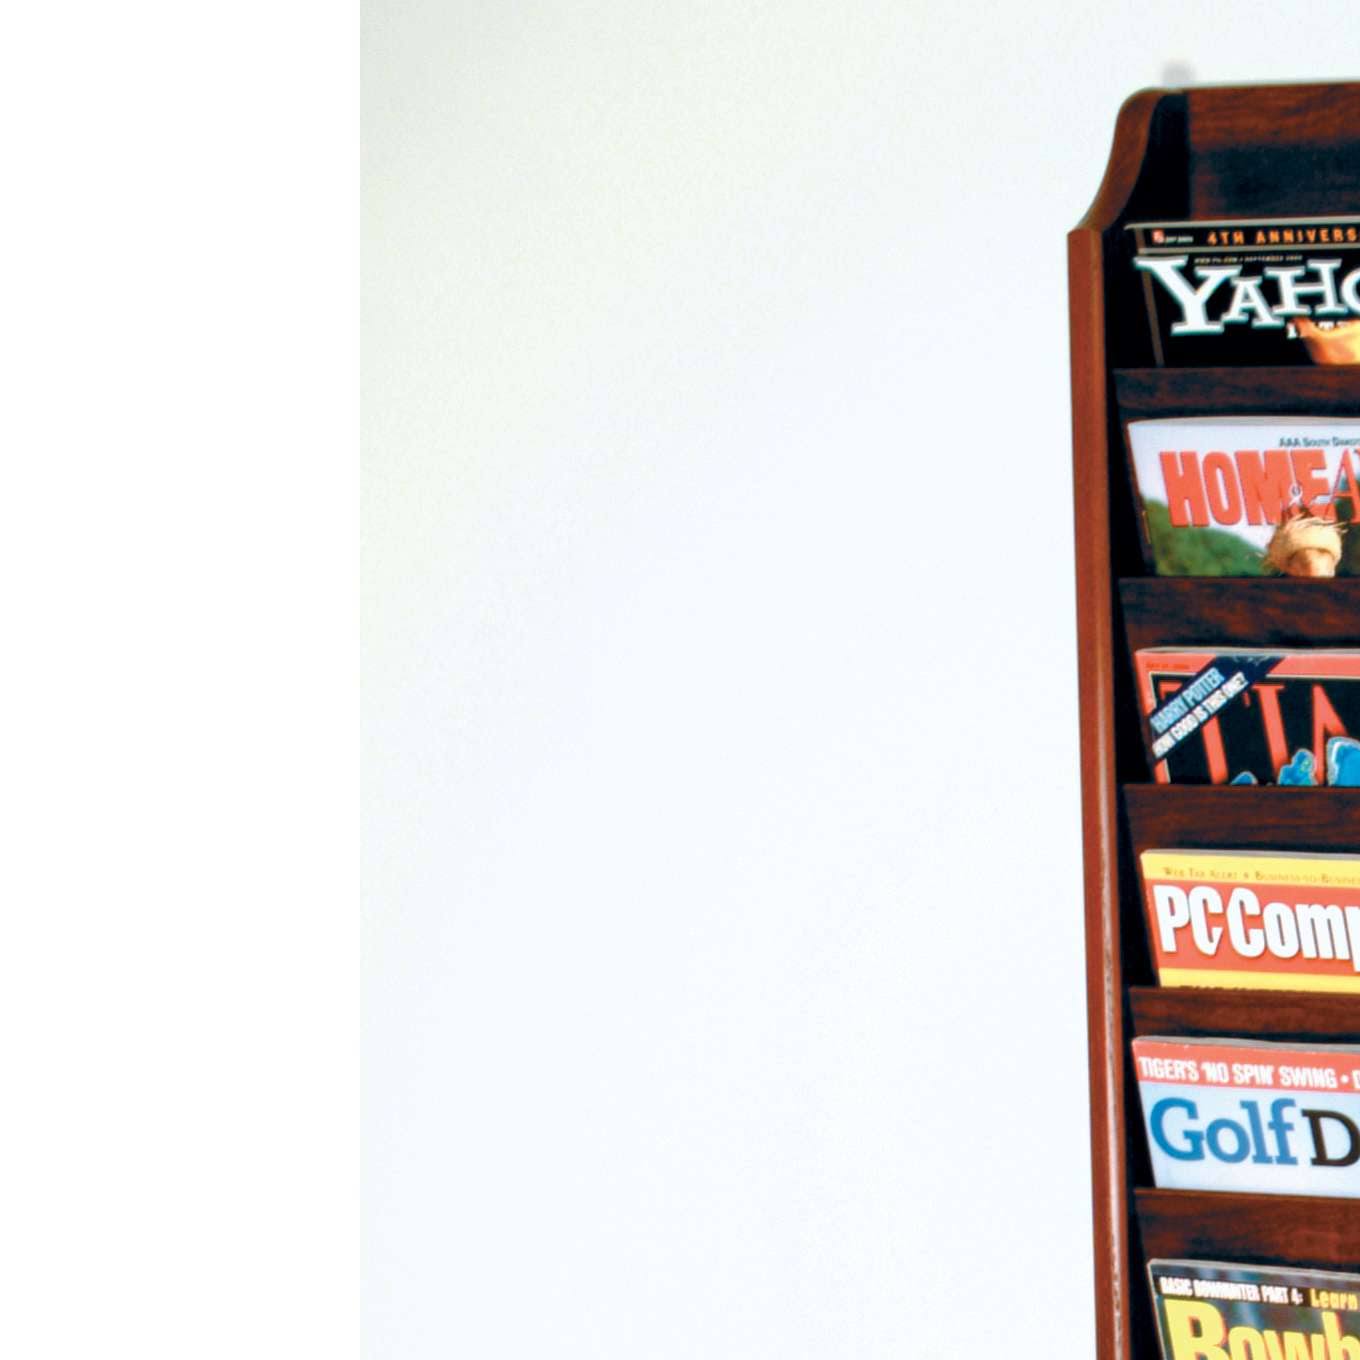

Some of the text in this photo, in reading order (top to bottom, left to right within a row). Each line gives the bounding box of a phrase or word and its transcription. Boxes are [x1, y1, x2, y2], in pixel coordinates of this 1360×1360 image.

[1207, 229, 1244, 246] 4TH
[1279, 436, 1301, 448] AAA
[1150, 667, 1226, 734] HARRY POTTER
[1171, 713, 1200, 742] GOOD
[1193, 704, 1209, 724] IS
[1202, 689, 1229, 716] THIS
[1138, 1055, 1200, 1082] TIGER'S
[1232, 1063, 1275, 1086] SPIN'
[1279, 1065, 1339, 1089] SWING
[1149, 1096, 1298, 1166] Golf
[1159, 1276, 1193, 1296] BASIC
[1261, 1284, 1289, 1304] PART
[1309, 1287, 1359, 1311] Learn
